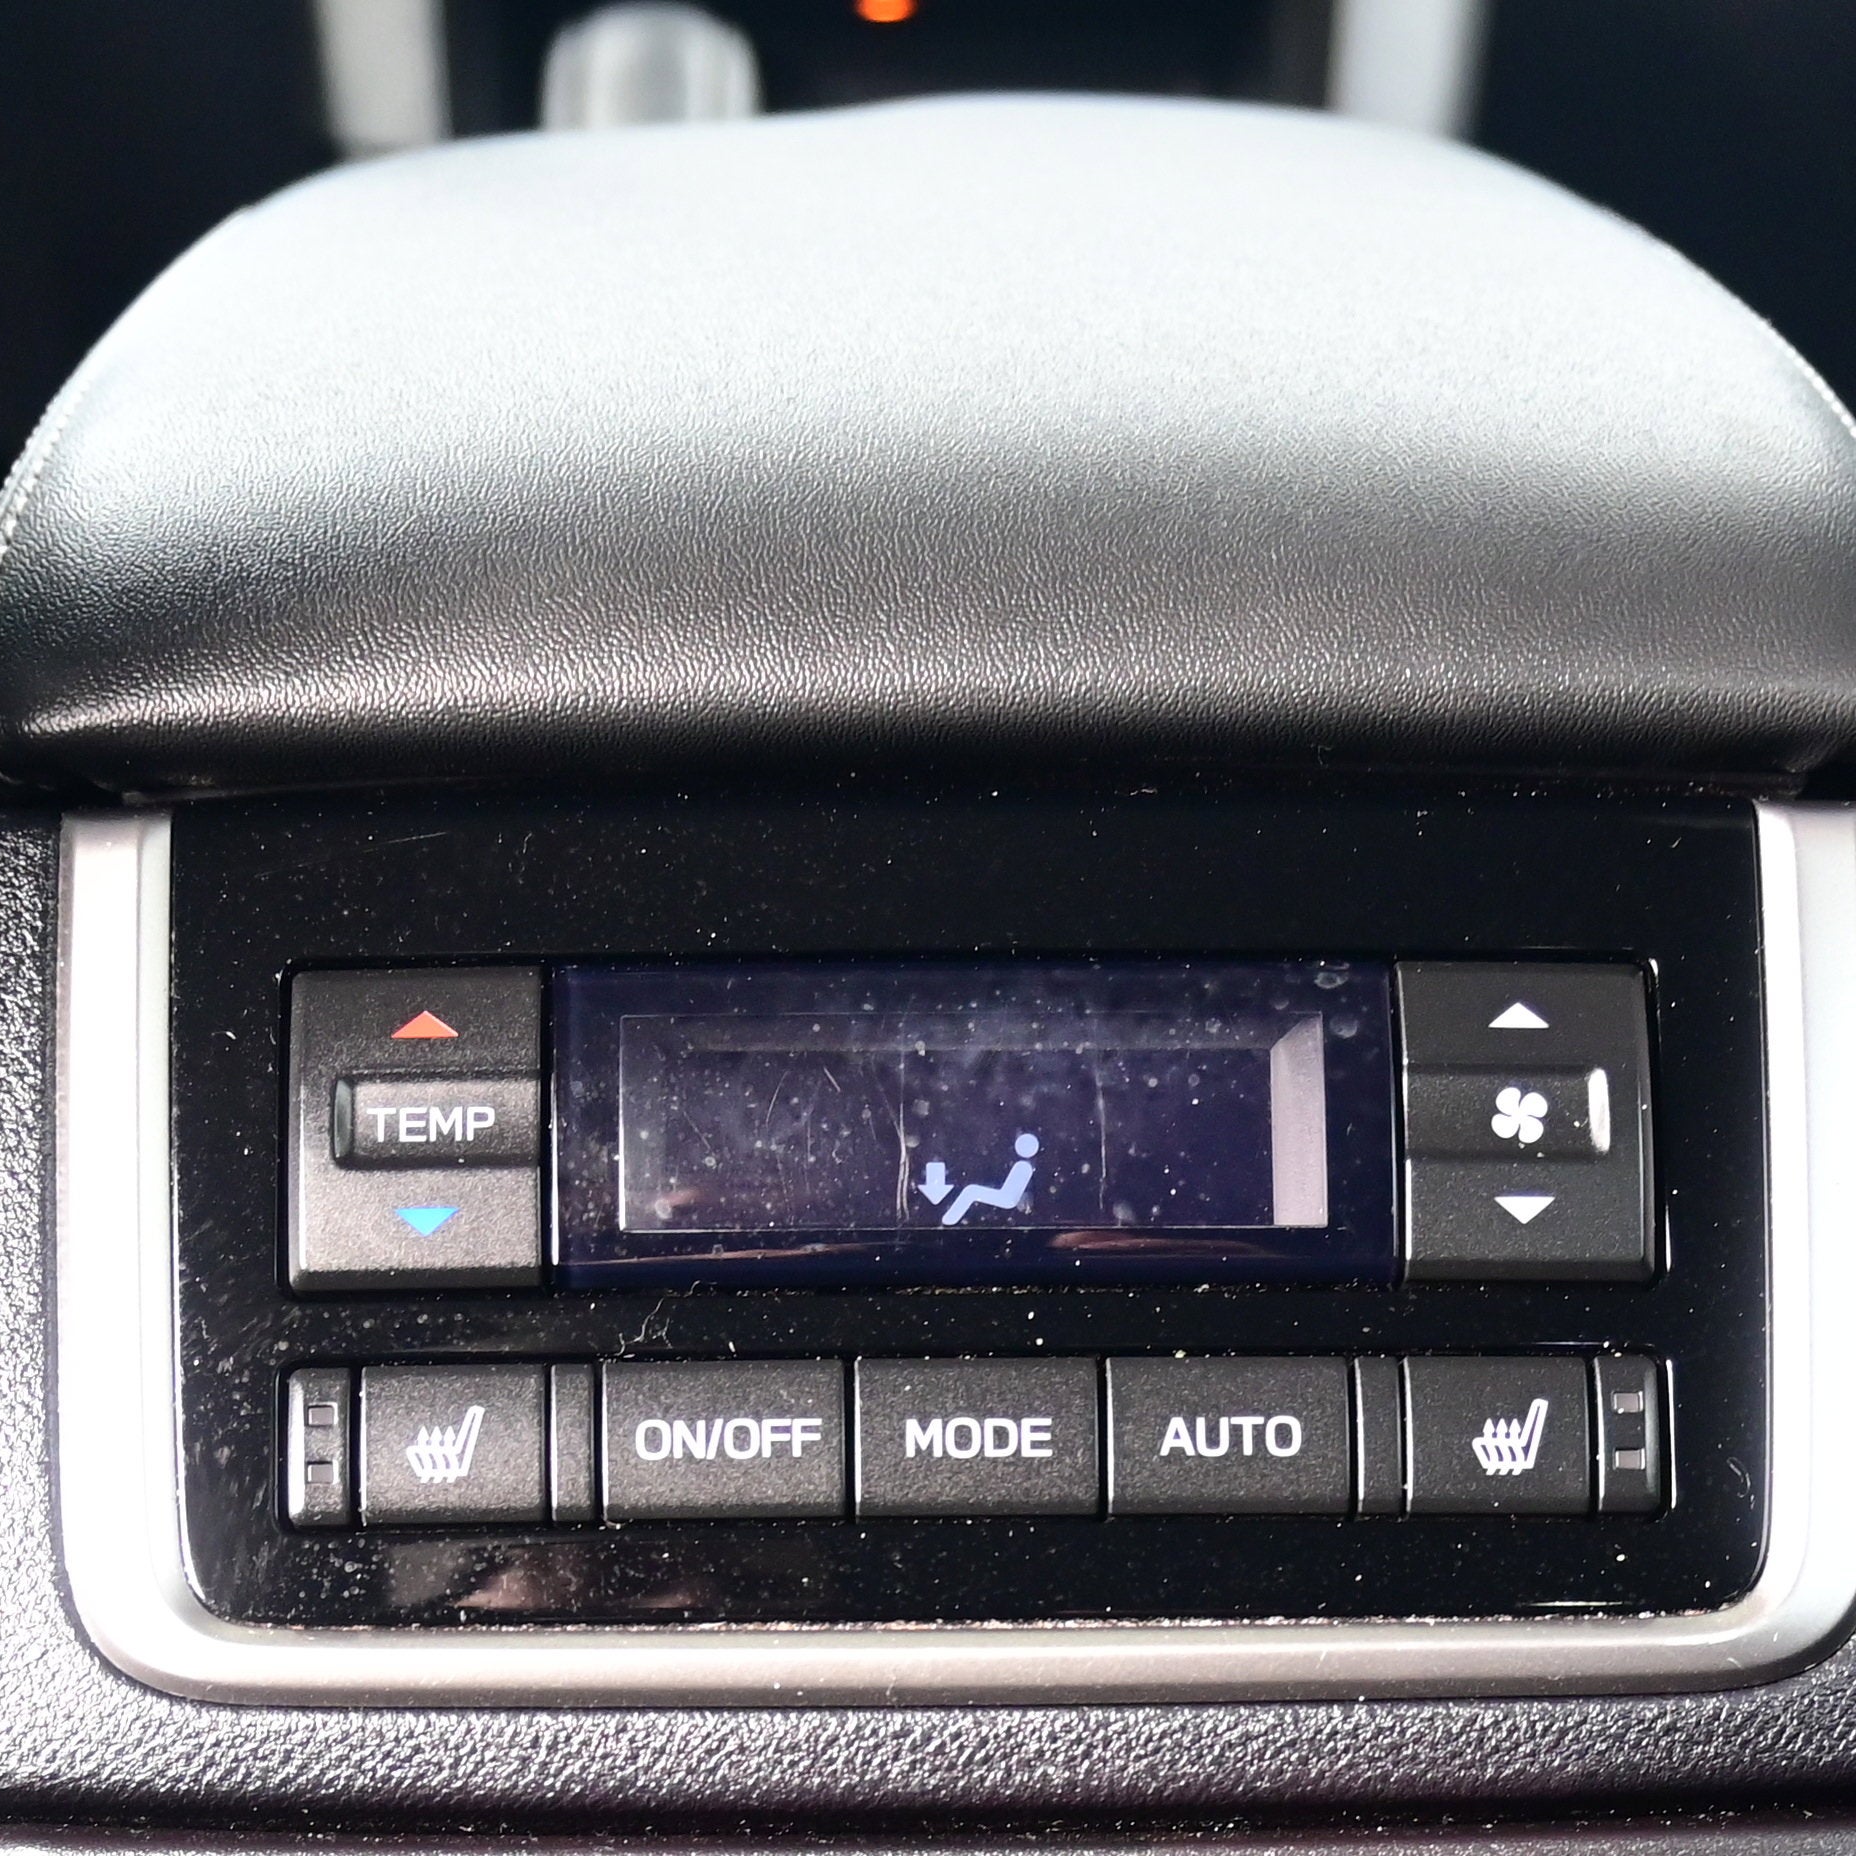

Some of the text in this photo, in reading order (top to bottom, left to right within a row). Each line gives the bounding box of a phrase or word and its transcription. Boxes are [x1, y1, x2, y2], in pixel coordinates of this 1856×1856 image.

[366, 1104, 495, 1142] TEMP
[633, 1417, 822, 1459] ON/OFF
[904, 1416, 1053, 1457] MODE
[1158, 1415, 1302, 1456] AUTO
